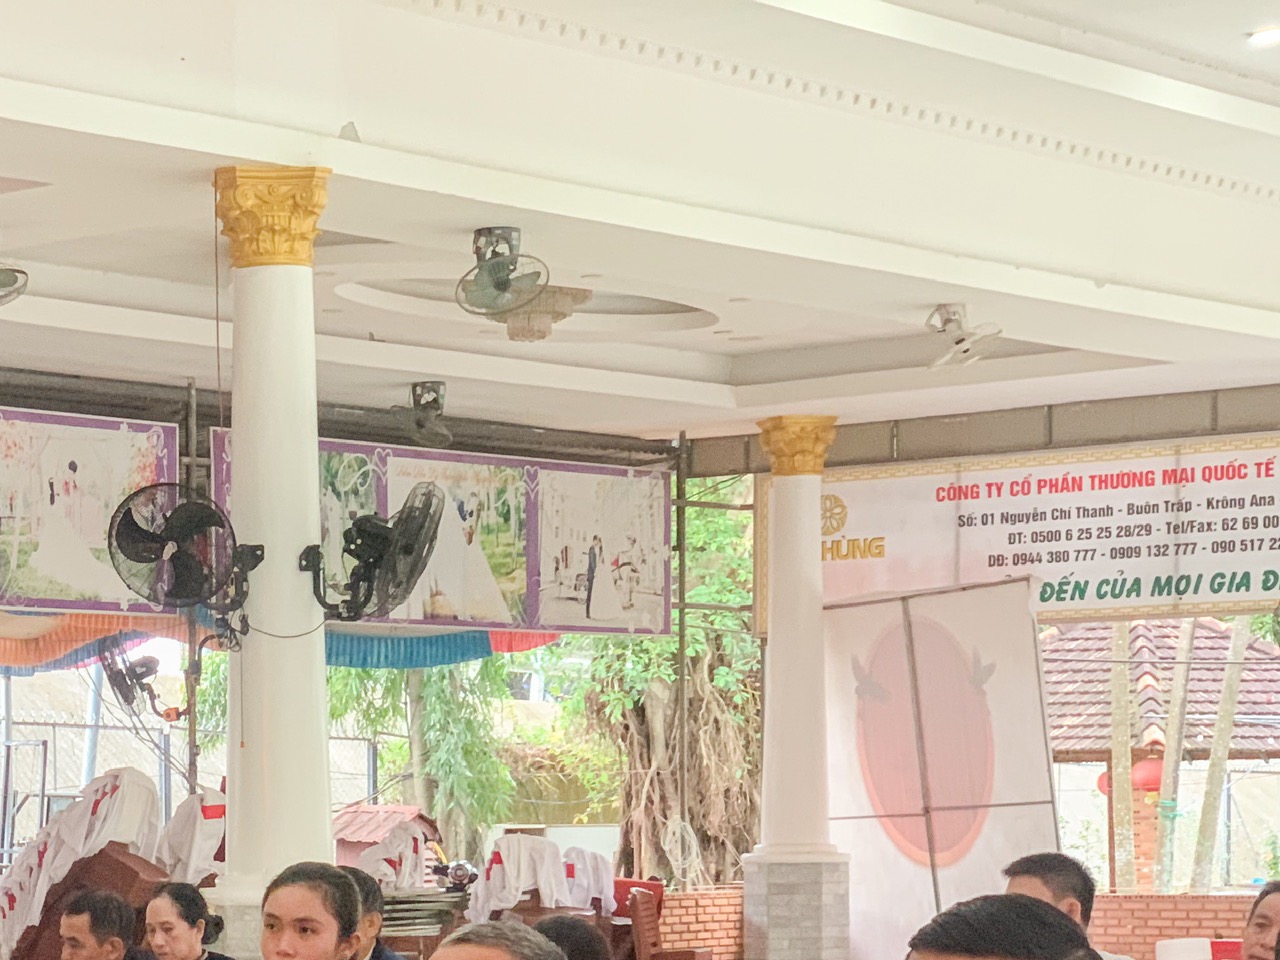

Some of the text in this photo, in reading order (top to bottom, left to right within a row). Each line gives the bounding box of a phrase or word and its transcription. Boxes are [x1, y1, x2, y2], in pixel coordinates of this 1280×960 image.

[935, 456, 1277, 502] CÔNG TY CỔ PHẦN THƯƠNG MẠI QUỐC TẾ
[957, 511, 977, 528] Số:
[981, 513, 995, 526] 01
[1000, 507, 1047, 526] Nguyễn
[1051, 506, 1072, 521] Chí
[1076, 504, 1114, 519] Thanh
[1127, 501, 1160, 516] Buôn
[1163, 497, 1192, 514] Trấp
[1206, 495, 1245, 511] Krông
[1249, 494, 1276, 508] Ana
[1008, 531, 1027, 545] ĐT:
[1031, 529, 1062, 544] 0500
[1065, 528, 1073, 541] 6
[1077, 527, 1093, 541] 25
[1096, 526, 1112, 540] 25
[1116, 523, 1152, 539] 28/29
[1165, 519, 1218, 536] Tel/Fax:
[1221, 517, 1238, 532] 62
[1242, 516, 1259, 531] 69
[1263, 514, 1280, 529] 00
[821, 535, 886, 562] HÙNG
[1012, 551, 1043, 566] 0944
[1046, 550, 1070, 564] 380
[1074, 548, 1097, 562] 777
[1110, 545, 1141, 560] 0909
[1147, 543, 1170, 558] 132
[1174, 541, 1198, 556] 777
[1211, 540, 1236, 554] 090
[1240, 538, 1265, 552] 517
[1269, 537, 1280, 551] 2
[1039, 569, 1280, 603] ĐẾN CỦA MỌI GIA Đ
